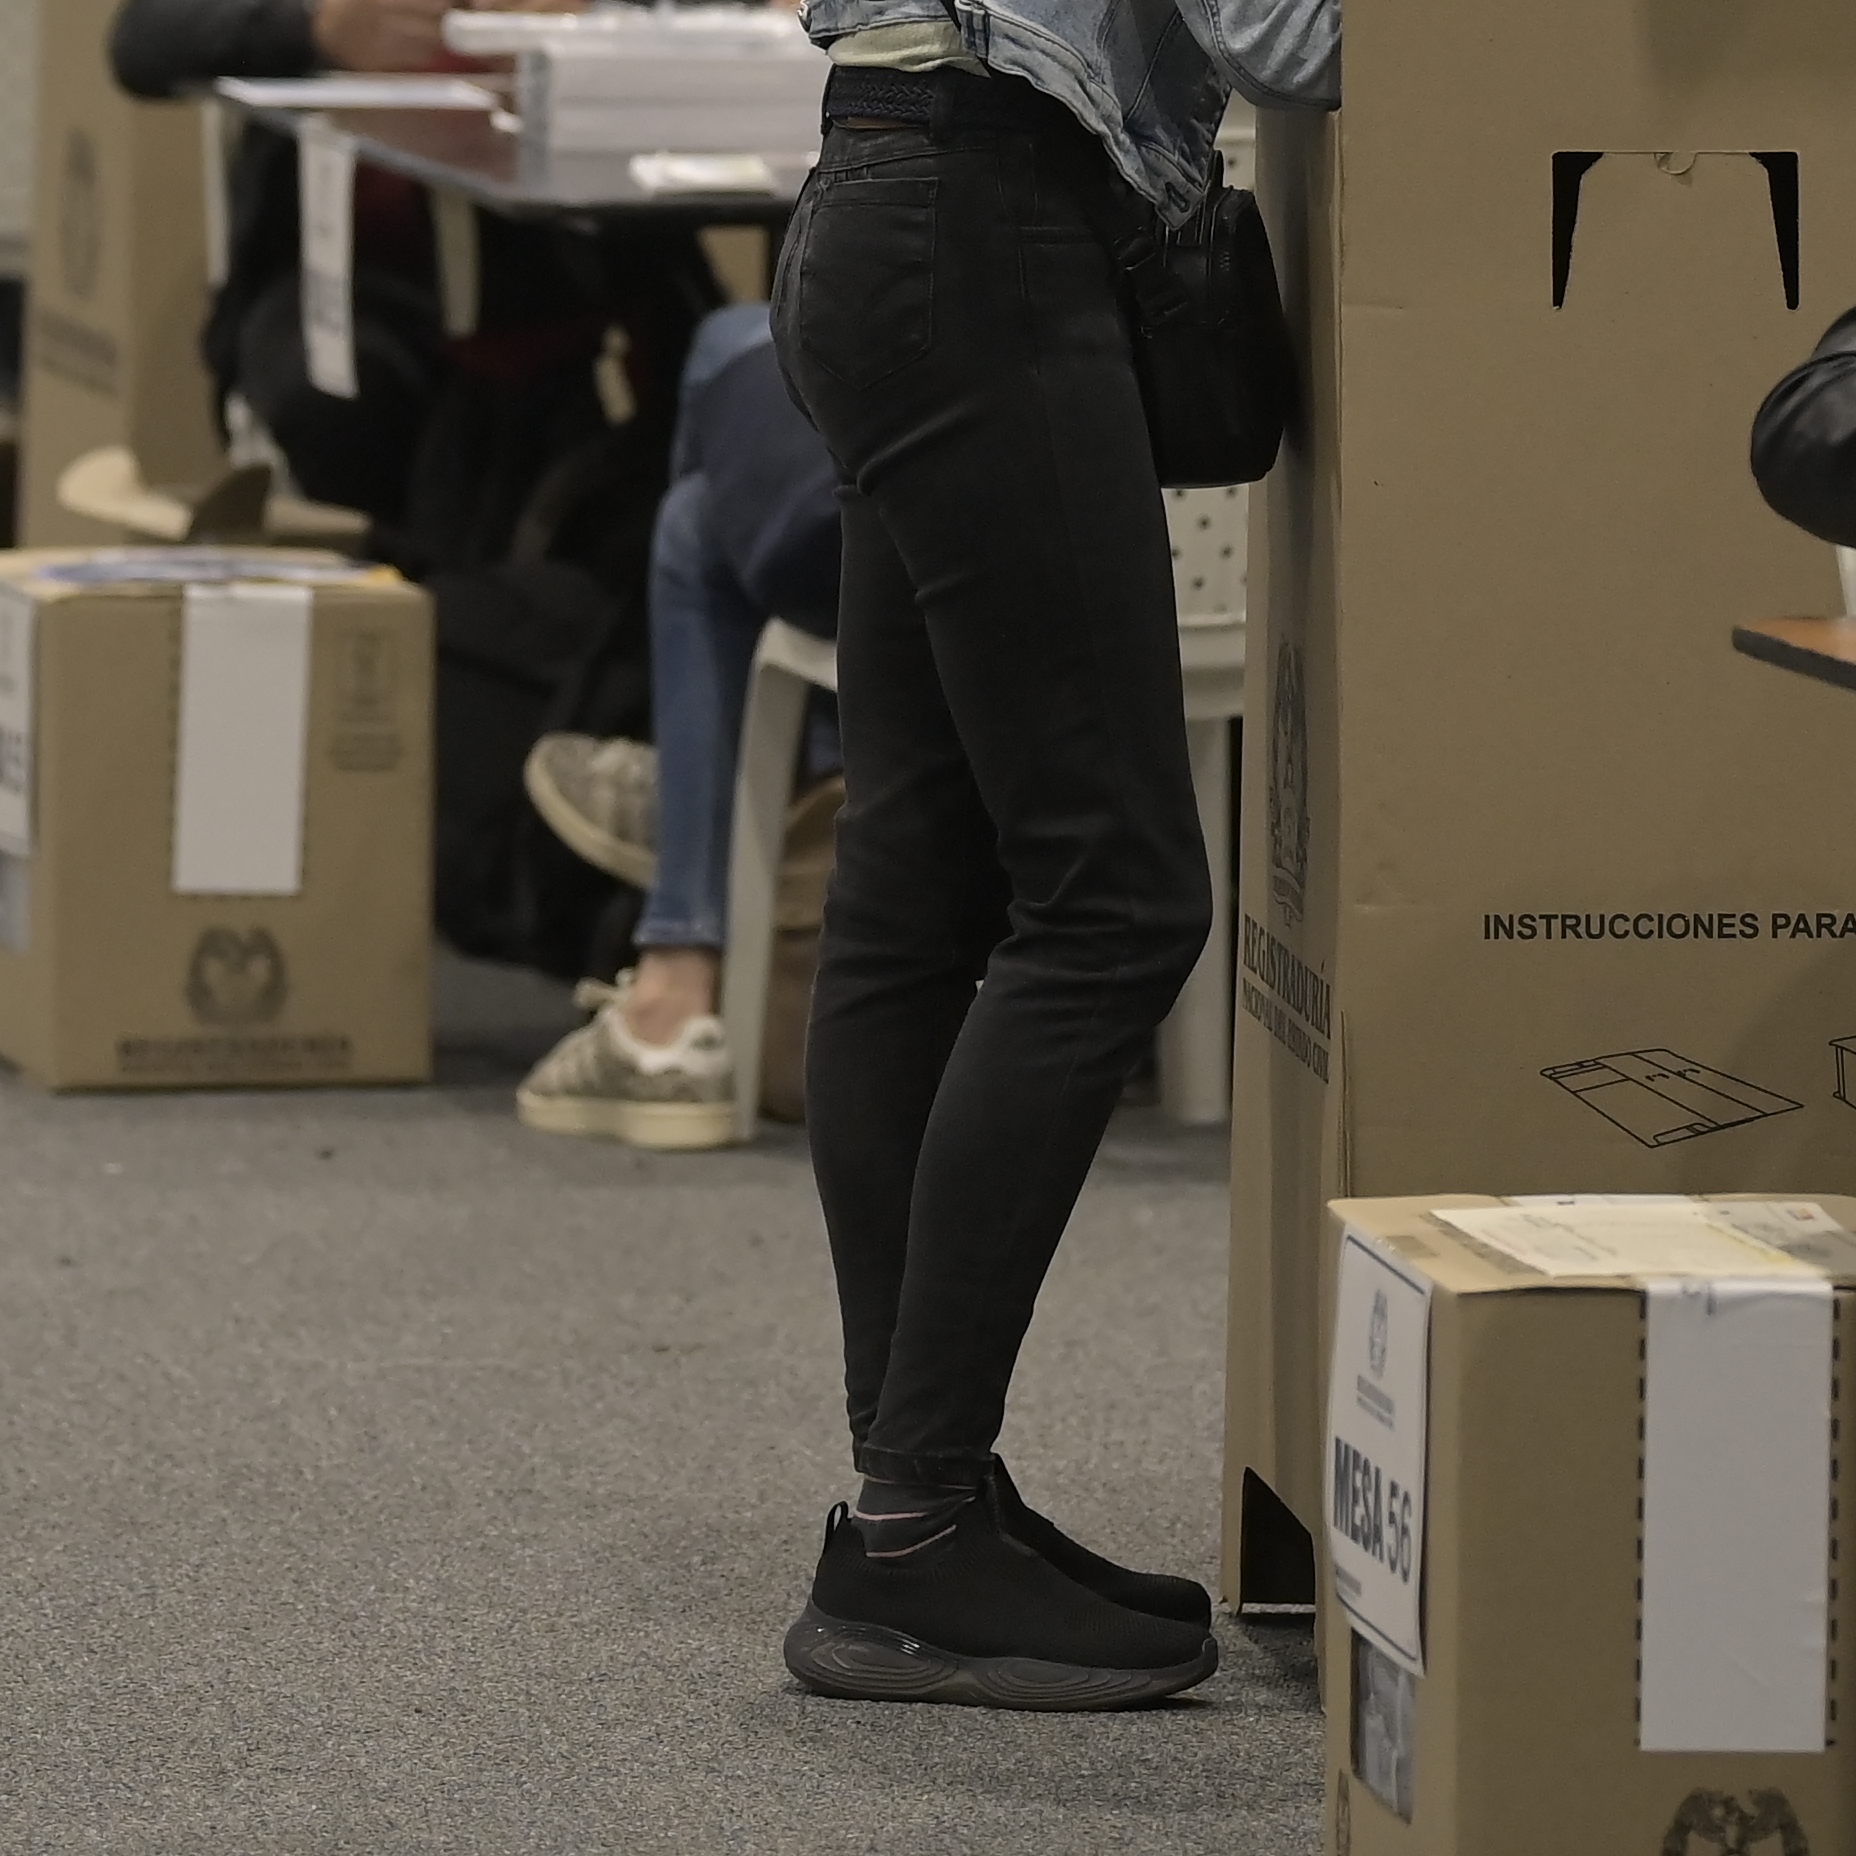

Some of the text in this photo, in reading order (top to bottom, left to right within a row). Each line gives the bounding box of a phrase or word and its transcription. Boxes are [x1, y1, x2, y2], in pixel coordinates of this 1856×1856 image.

[1243, 912, 1331, 1041] REGISTRADURÍA
[1483, 912, 1760, 941] INSTRUCCIONES
[1333, 1436, 1413, 1586] MESA 56
